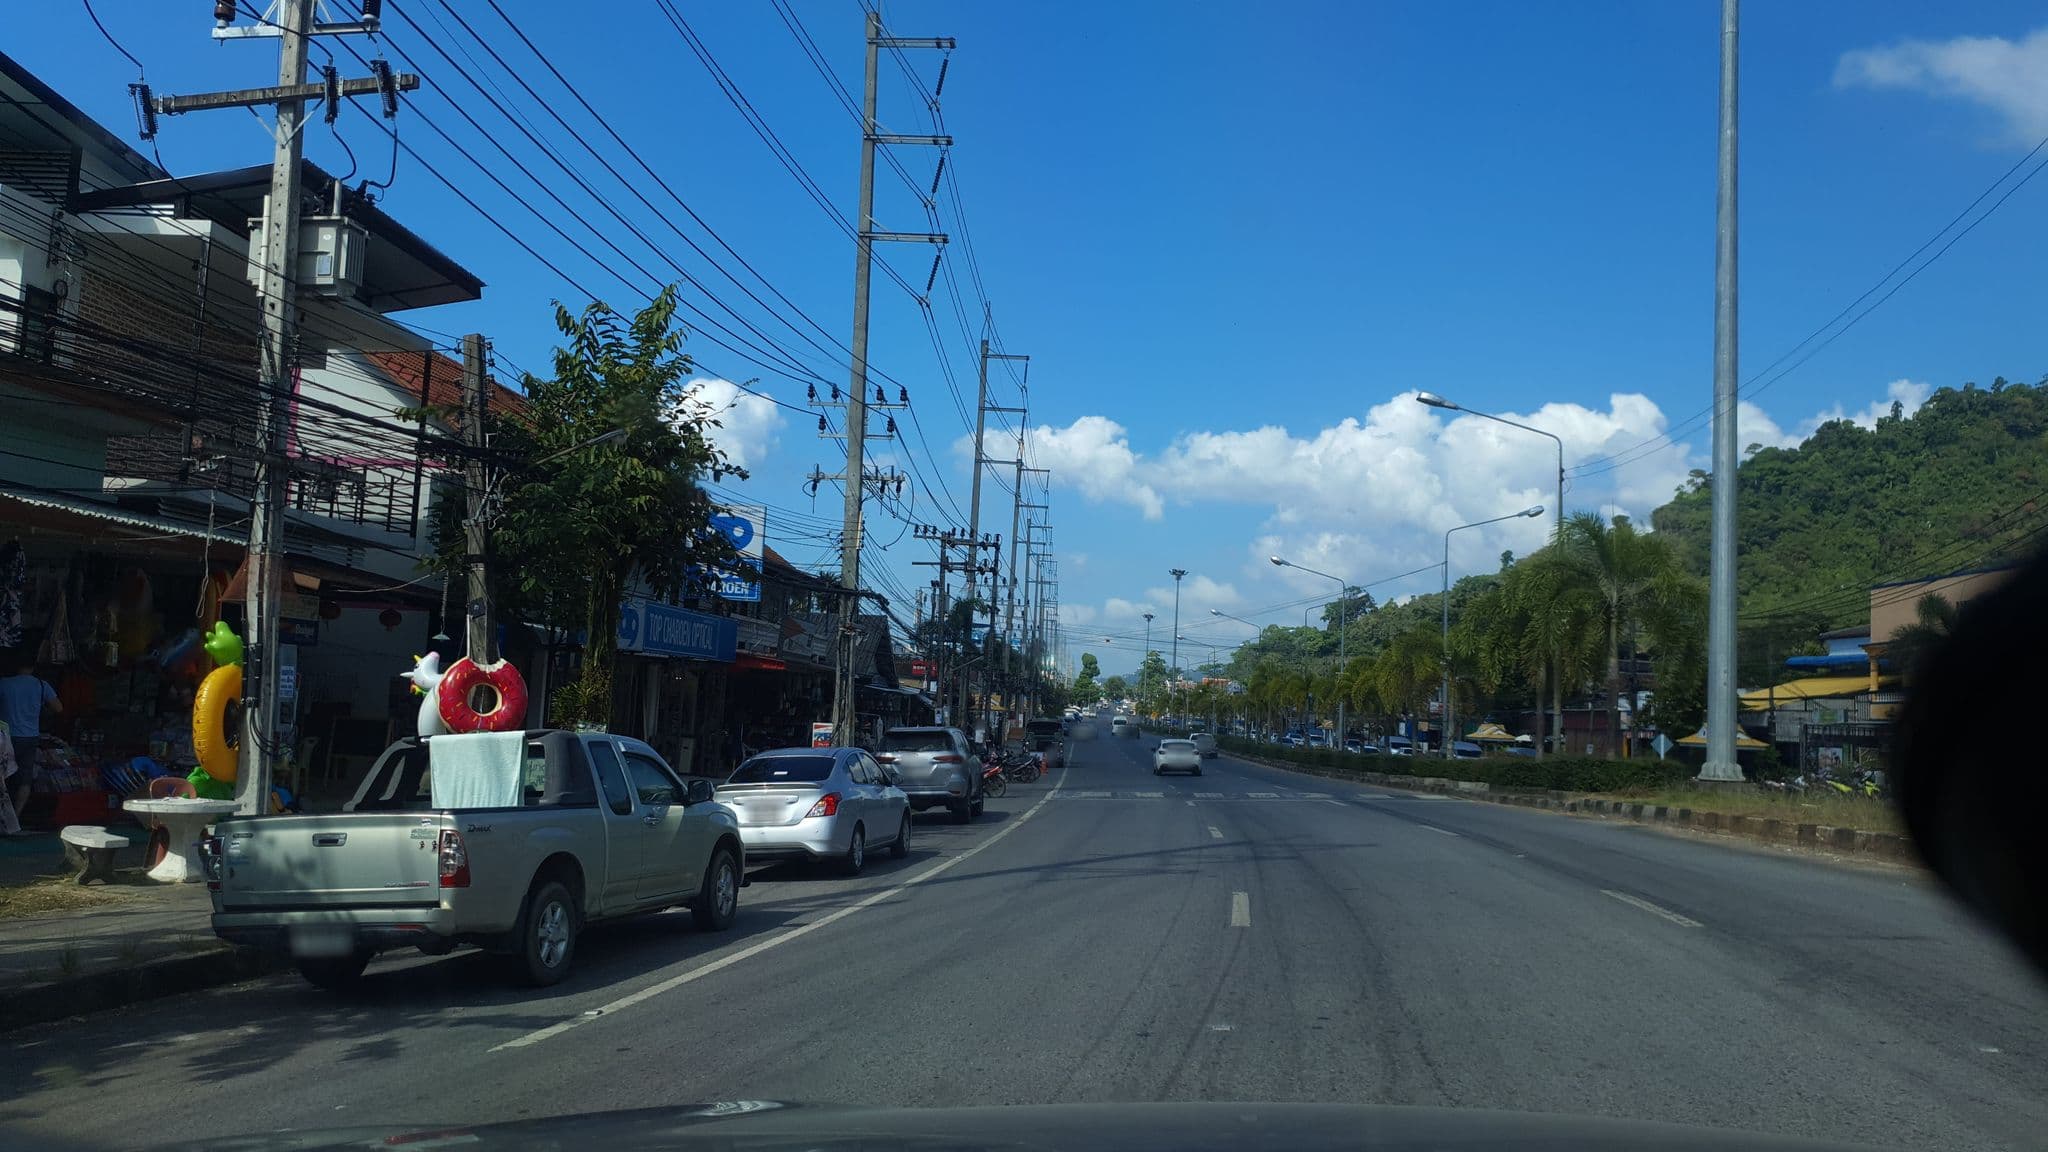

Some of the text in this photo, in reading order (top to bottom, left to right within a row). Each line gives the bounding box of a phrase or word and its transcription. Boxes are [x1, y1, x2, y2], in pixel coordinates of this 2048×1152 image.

[649, 612, 713, 651] TOP CHAROEN OPTICAL
